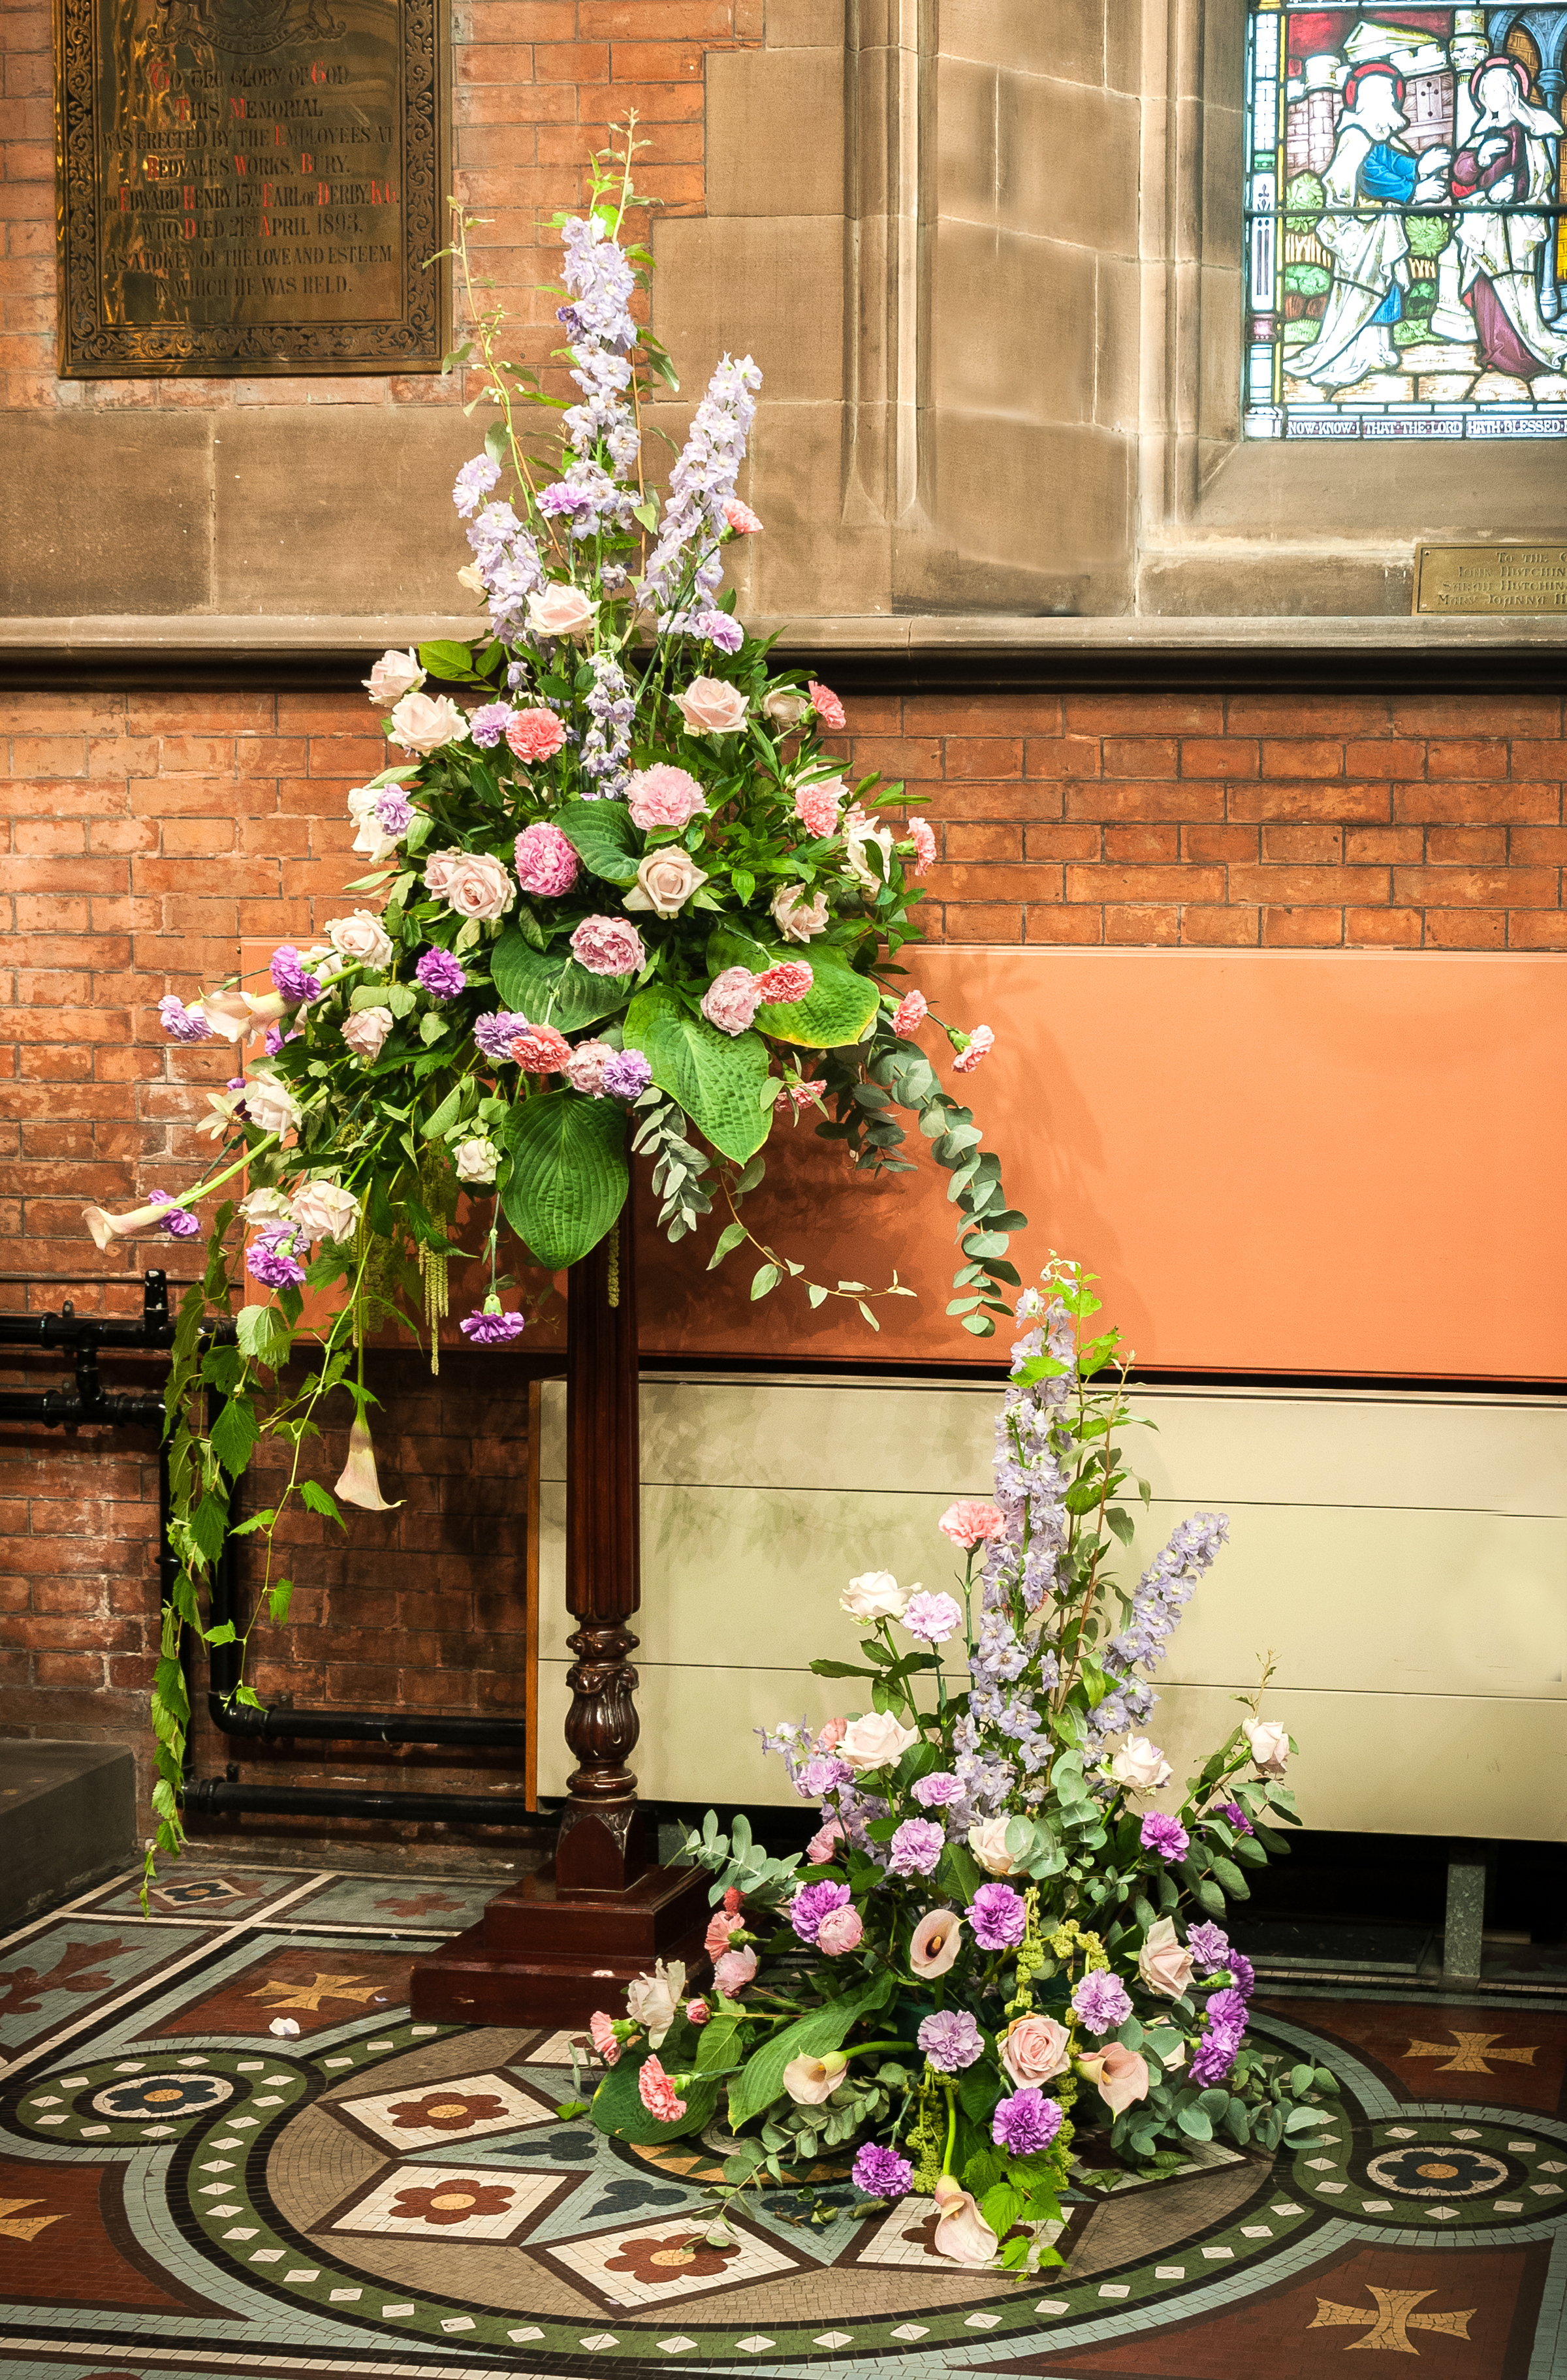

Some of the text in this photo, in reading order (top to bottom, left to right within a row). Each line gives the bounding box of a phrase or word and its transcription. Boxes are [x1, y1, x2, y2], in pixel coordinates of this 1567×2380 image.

[230, 67, 283, 87] GLORY
[311, 61, 348, 85] GOD
[174, 98, 323, 120] THIS MEMORIAL
[136, 132, 207, 149] ERECTED
[212, 131, 230, 147] BY
[237, 129, 269, 146] THE
[274, 125, 370, 146] EMPLOYEES
[147, 157, 229, 179] REDVALES
[120, 187, 179, 211] EDWARD
[184, 185, 230, 210] HENRY
[262, 183, 302, 208] EARL
[185, 218, 225, 239] DIED
[259, 216, 311, 237] APRIL
[222, 249, 252, 266] THE
[256, 247, 291, 266] LOVE
[294, 247, 324, 264] AND
[328, 245, 392, 264] ESTEEM
[174, 278, 229, 298] WHICH
[261, 276, 298, 295] WAS
[1288, 421, 1315, 435] NOW
[1318, 421, 1352, 435] KNOW
[1364, 421, 1397, 435] THAT
[1400, 421, 1427, 434] THE
[1430, 420, 1463, 434] LORD
[1468, 420, 1501, 434] HATH
[1504, 420, 1560, 433] BLESSED
